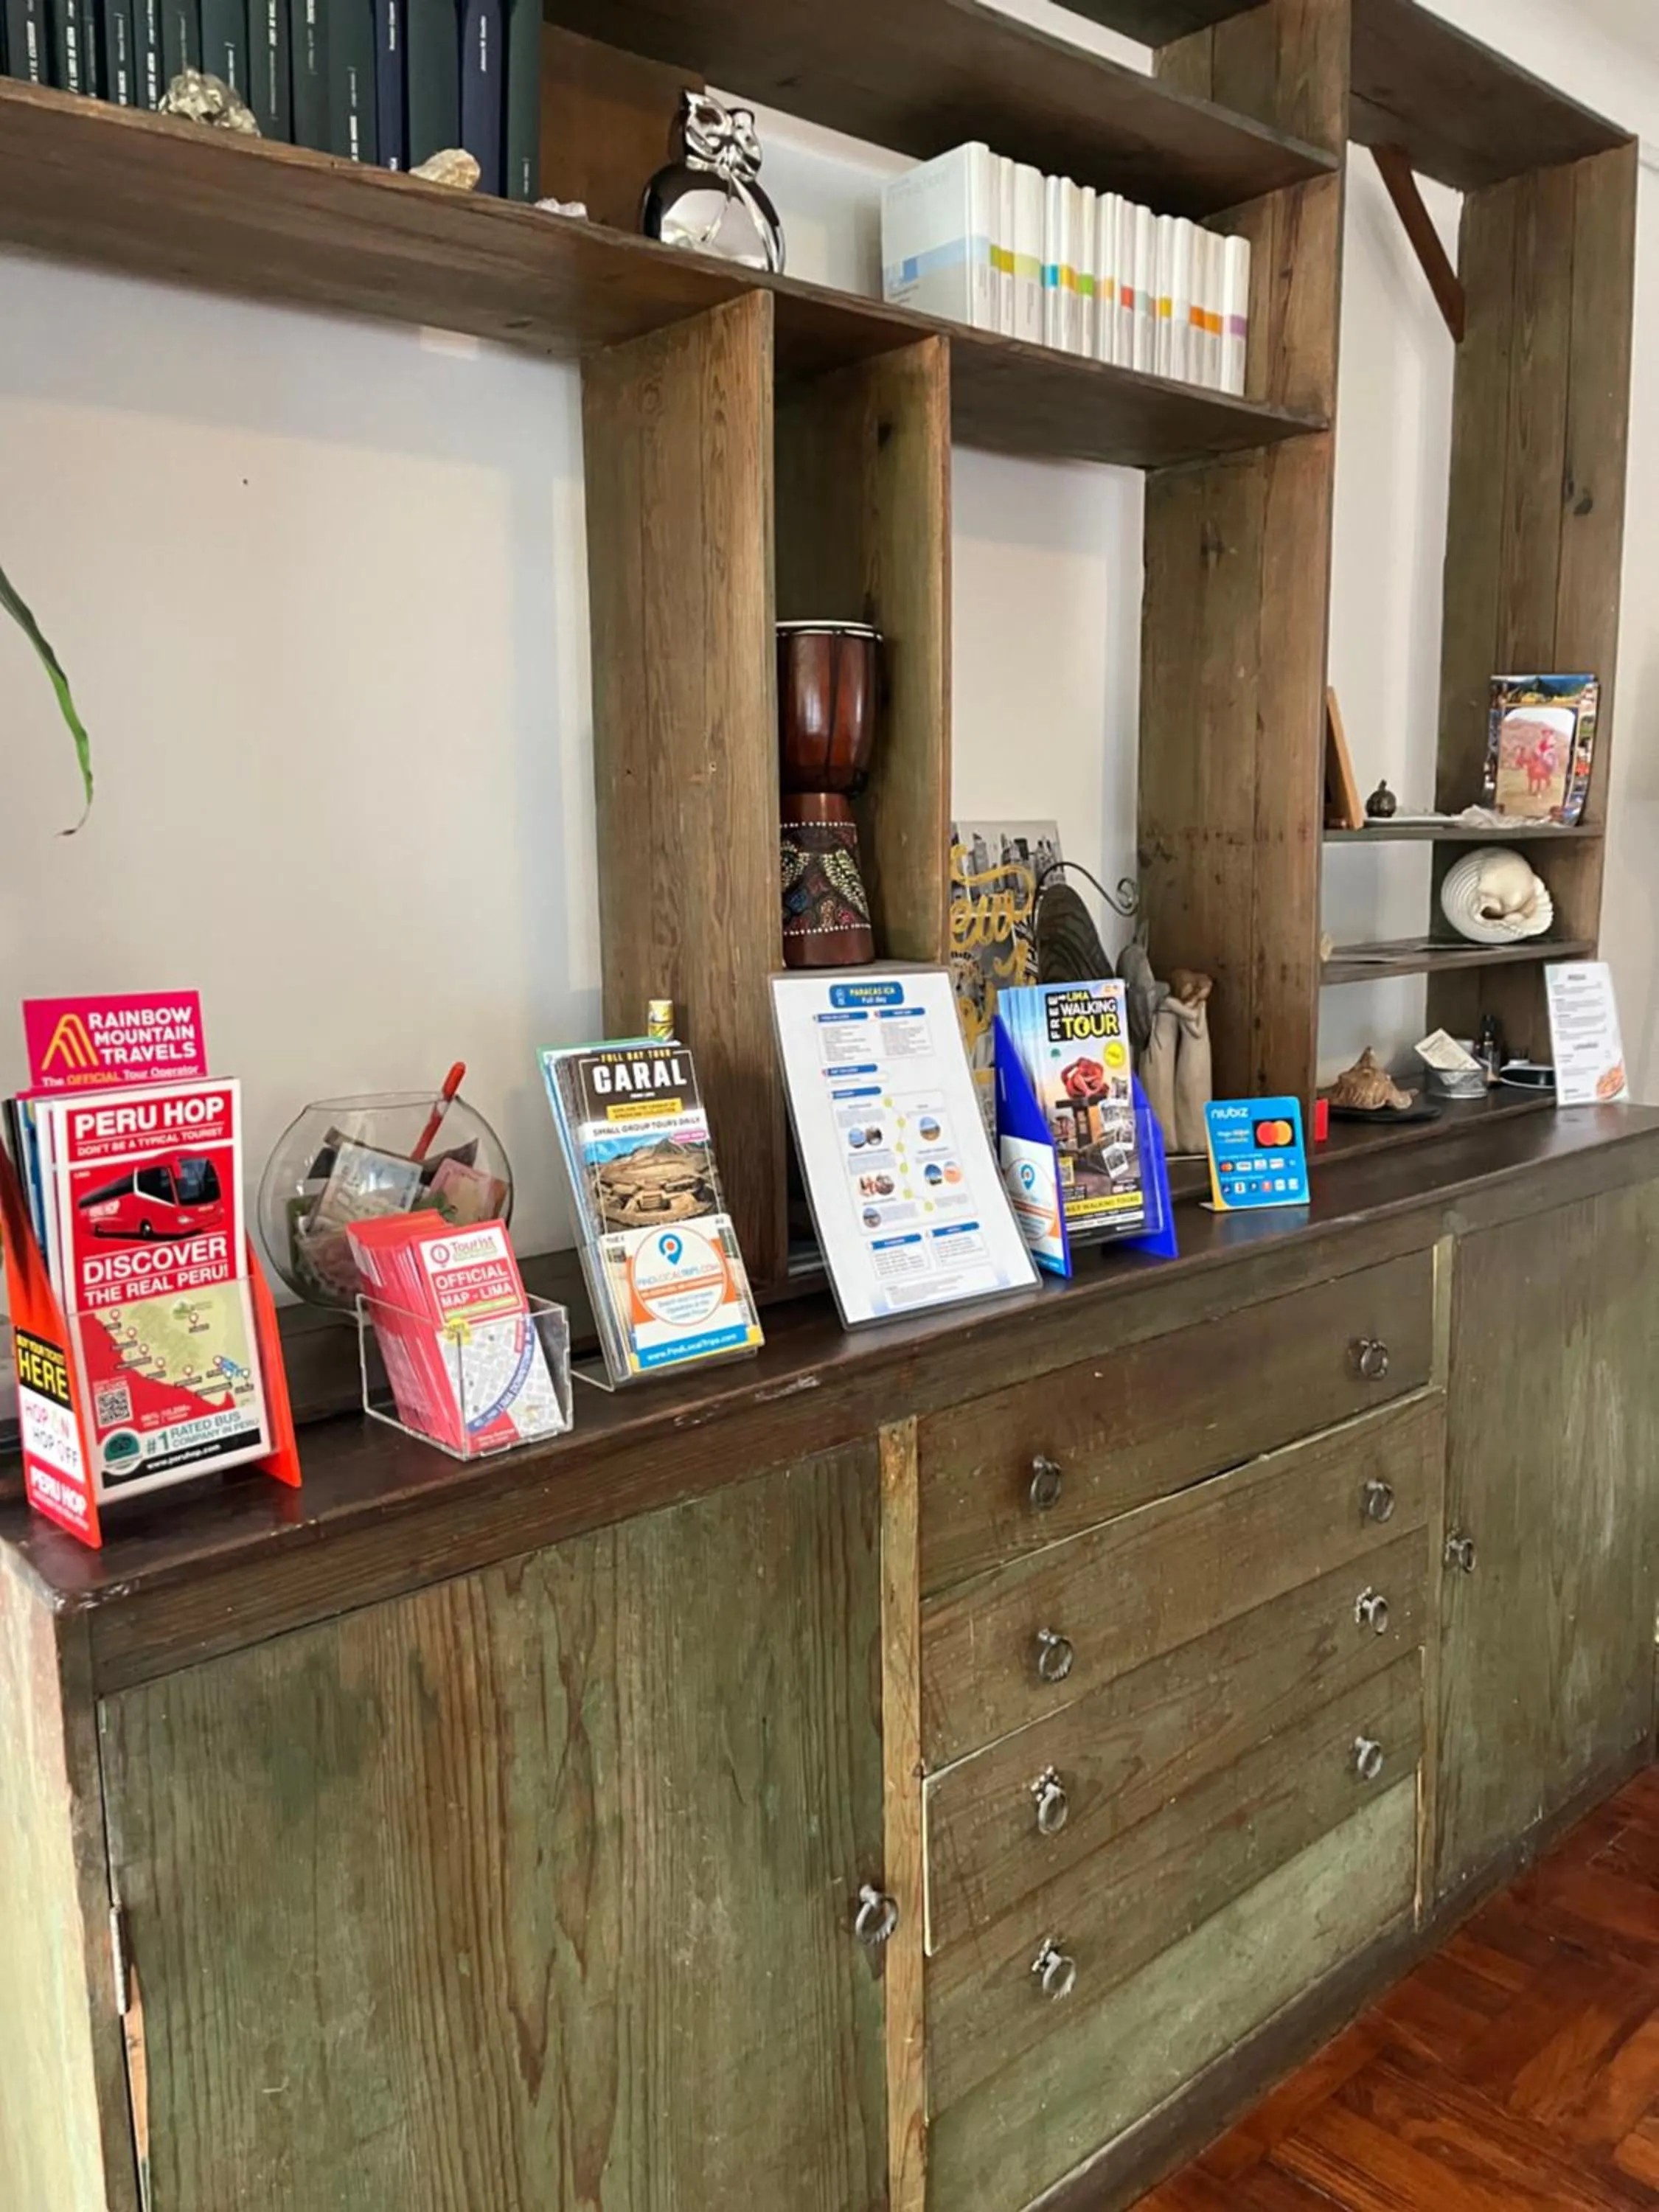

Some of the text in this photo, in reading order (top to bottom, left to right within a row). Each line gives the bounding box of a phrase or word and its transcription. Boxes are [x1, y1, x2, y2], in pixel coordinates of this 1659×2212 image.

[1060, 999, 1116, 1015] WALKING
[1067, 991, 1089, 1001] LIMA
[88, 1006, 193, 1029] RAINBOW
[1048, 996, 1061, 1039] FREE
[1062, 1013, 1119, 1039] TOUR
[94, 1025, 195, 1046] MOUNTAIN
[100, 1041, 197, 1065] TRAVELS
[601, 1052, 623, 1063] FULL
[648, 1048, 672, 1060] TOUR
[42, 1065, 201, 1088] The OFFICIAL Tour Operator
[592, 1058, 688, 1094] CARAL
[74, 1096, 225, 1140] PERU HOP
[593, 1127, 621, 1136] SMALL
[622, 1122, 650, 1133] GROUP
[652, 1119, 677, 1129] TOURS
[77, 1127, 224, 1157] DON'T BE A TYPICAL TOURIST
[451, 1236, 493, 1253] Tourist
[83, 1237, 227, 1284] DISCOVER
[85, 1265, 229, 1307] THE REAL PERU!
[436, 1262, 508, 1290] OFFICIAL
[441, 1291, 470, 1307] MAP
[480, 1283, 514, 1299] LIMA
[18, 1348, 69, 1400] HERE
[146, 1431, 169, 1455] #1
[170, 1419, 212, 1439] RATED
[215, 1411, 241, 1427] BUS
[173, 1429, 220, 1447] COMPANY
[222, 1425, 232, 1436] IN
